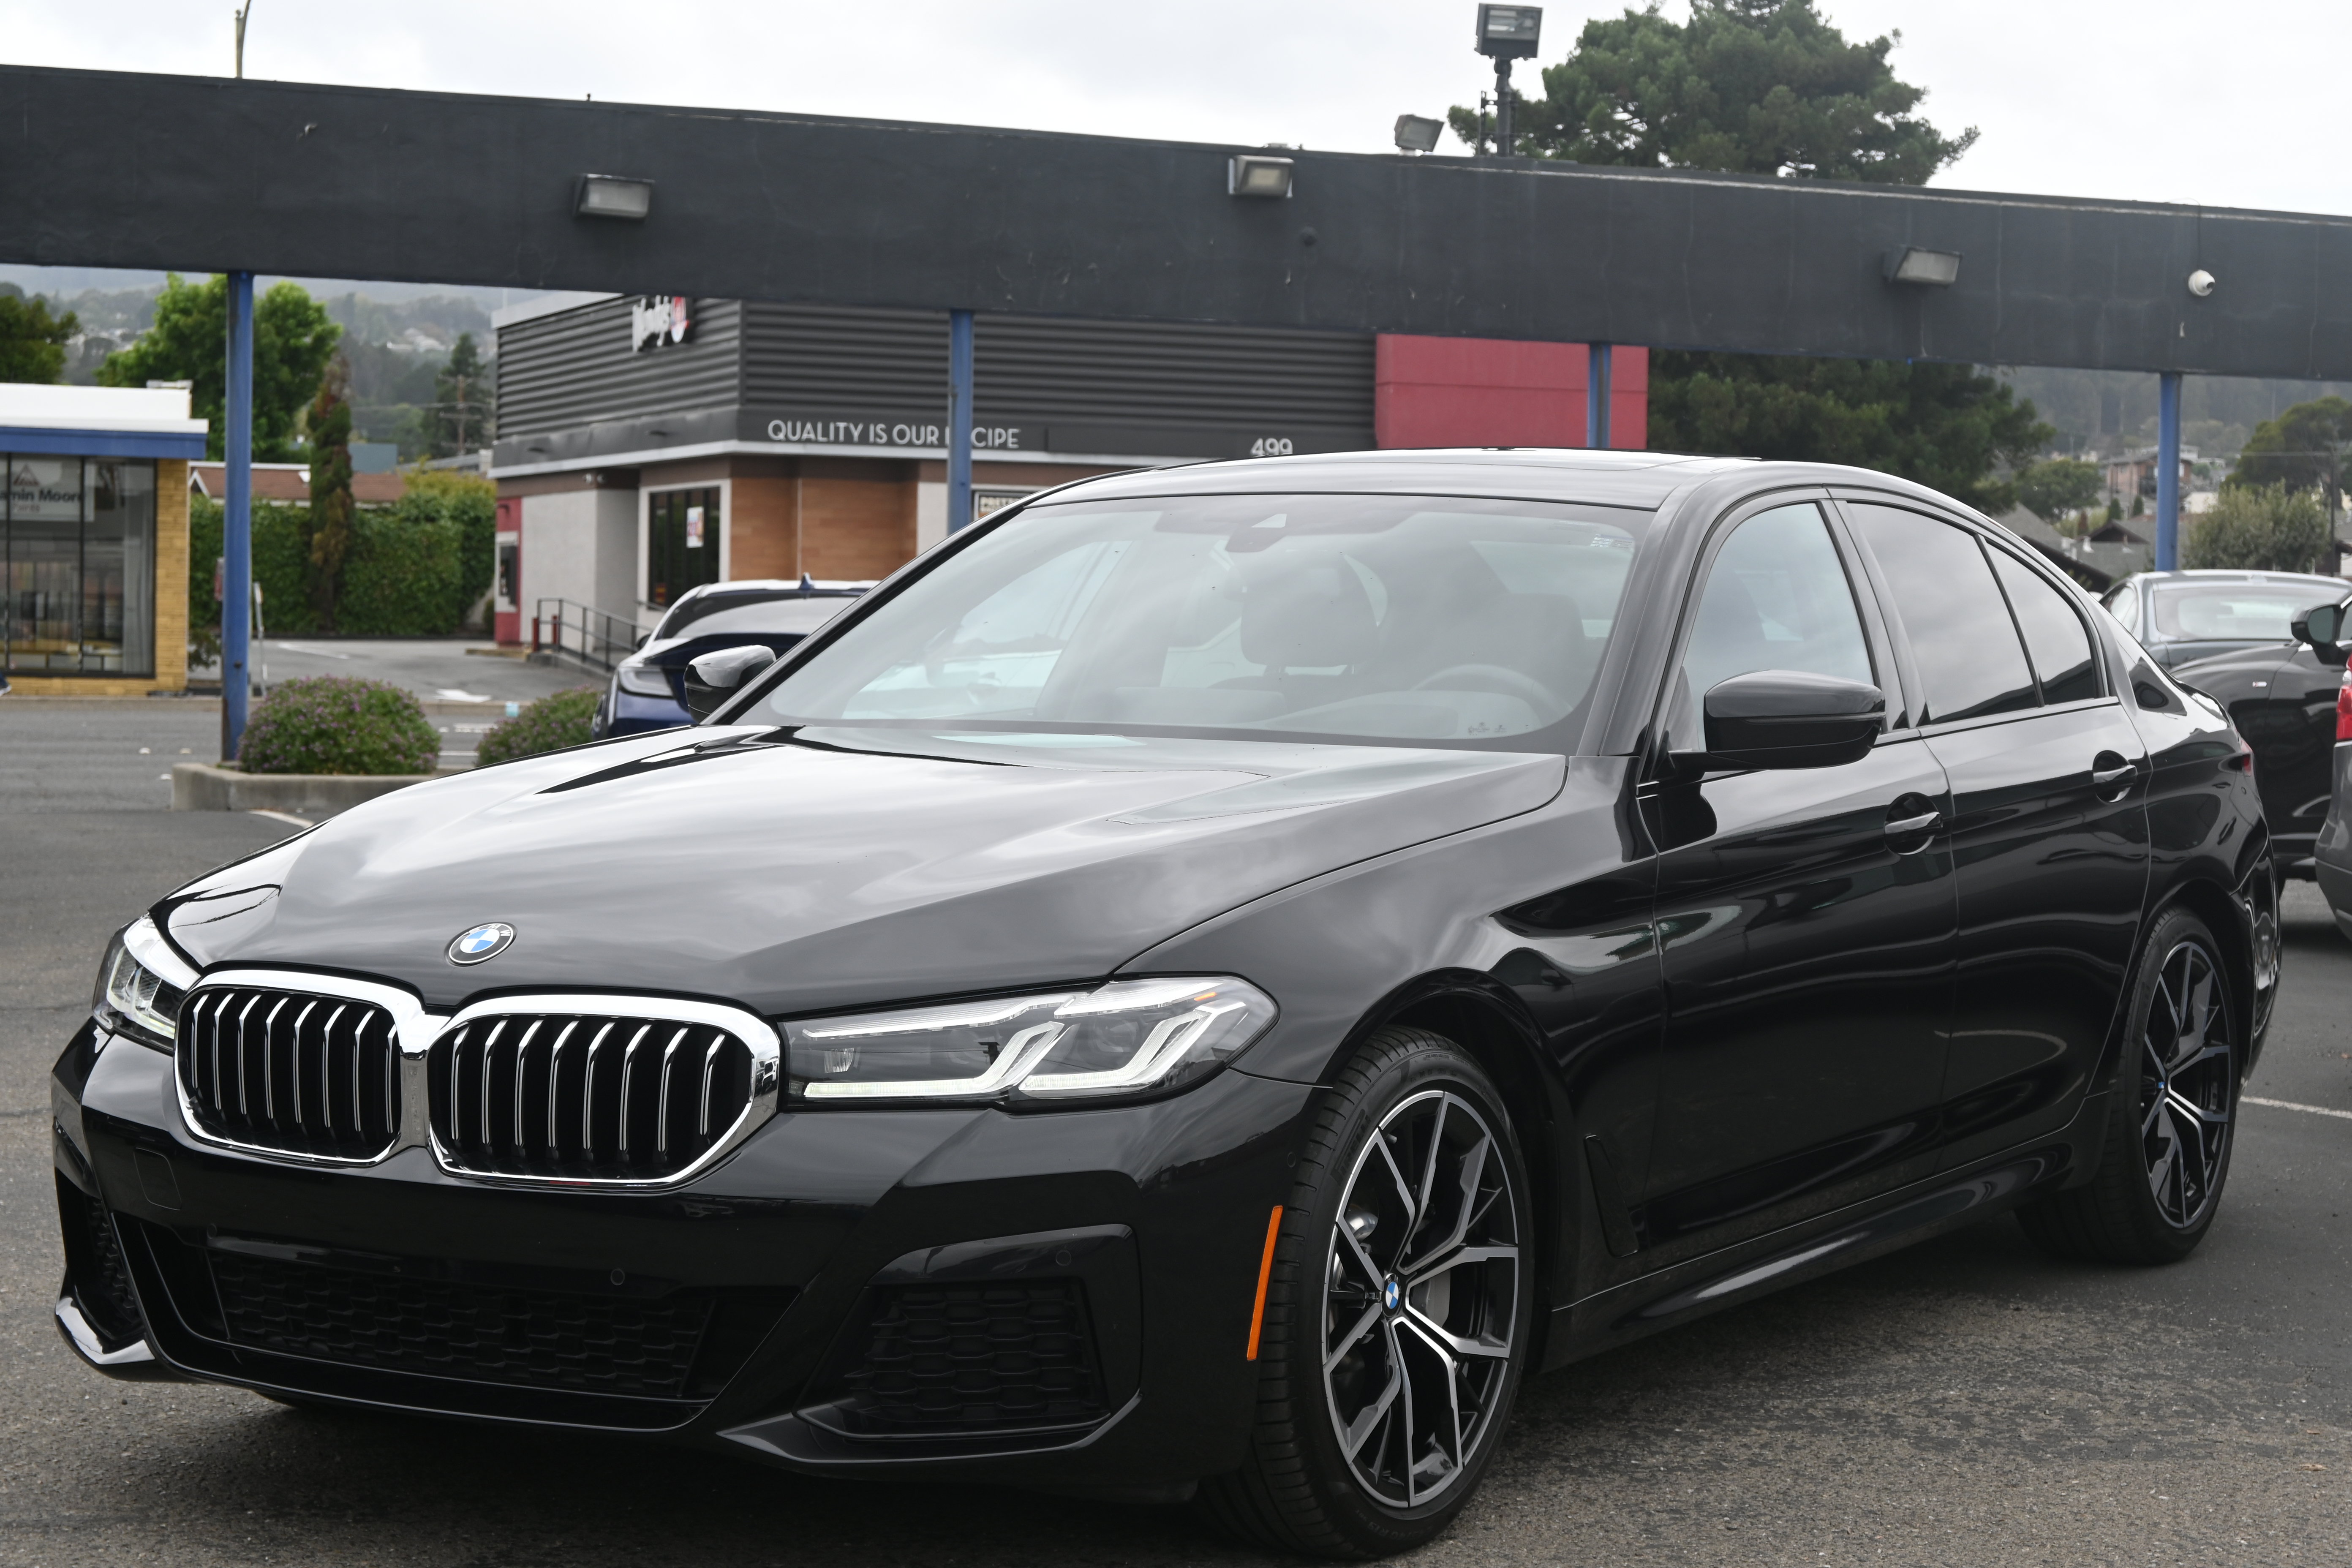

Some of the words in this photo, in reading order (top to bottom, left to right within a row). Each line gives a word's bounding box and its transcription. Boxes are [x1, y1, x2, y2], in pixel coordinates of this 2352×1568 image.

[768, 419, 864, 443] QUALITY
[869, 423, 888, 444] IS
[892, 424, 939, 446] OUR
[945, 427, 1020, 449] CIPE
[1250, 437, 1293, 457] 499
